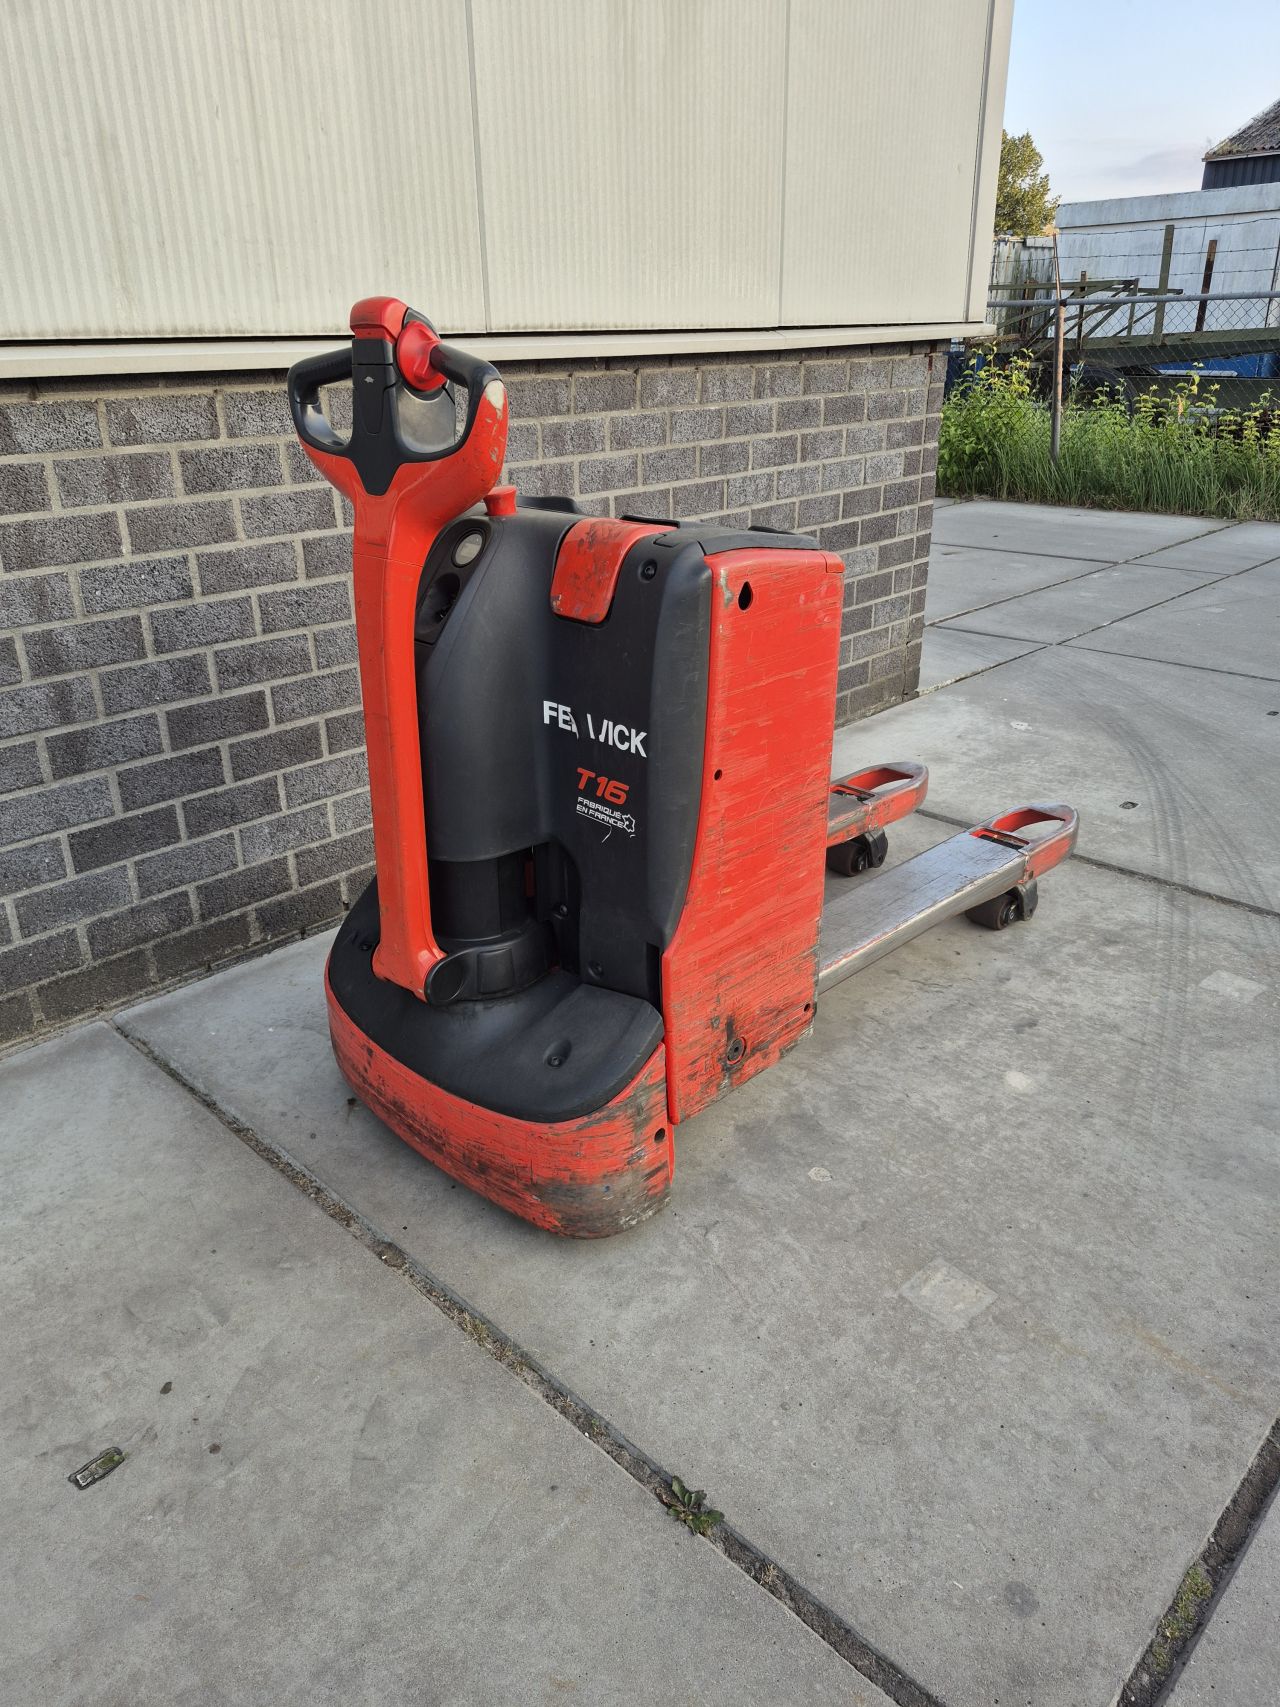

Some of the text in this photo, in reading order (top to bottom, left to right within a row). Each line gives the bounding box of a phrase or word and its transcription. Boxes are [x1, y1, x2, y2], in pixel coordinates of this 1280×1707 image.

[577, 767, 629, 805] T16
[576, 804, 625, 829] EN FRANCE
